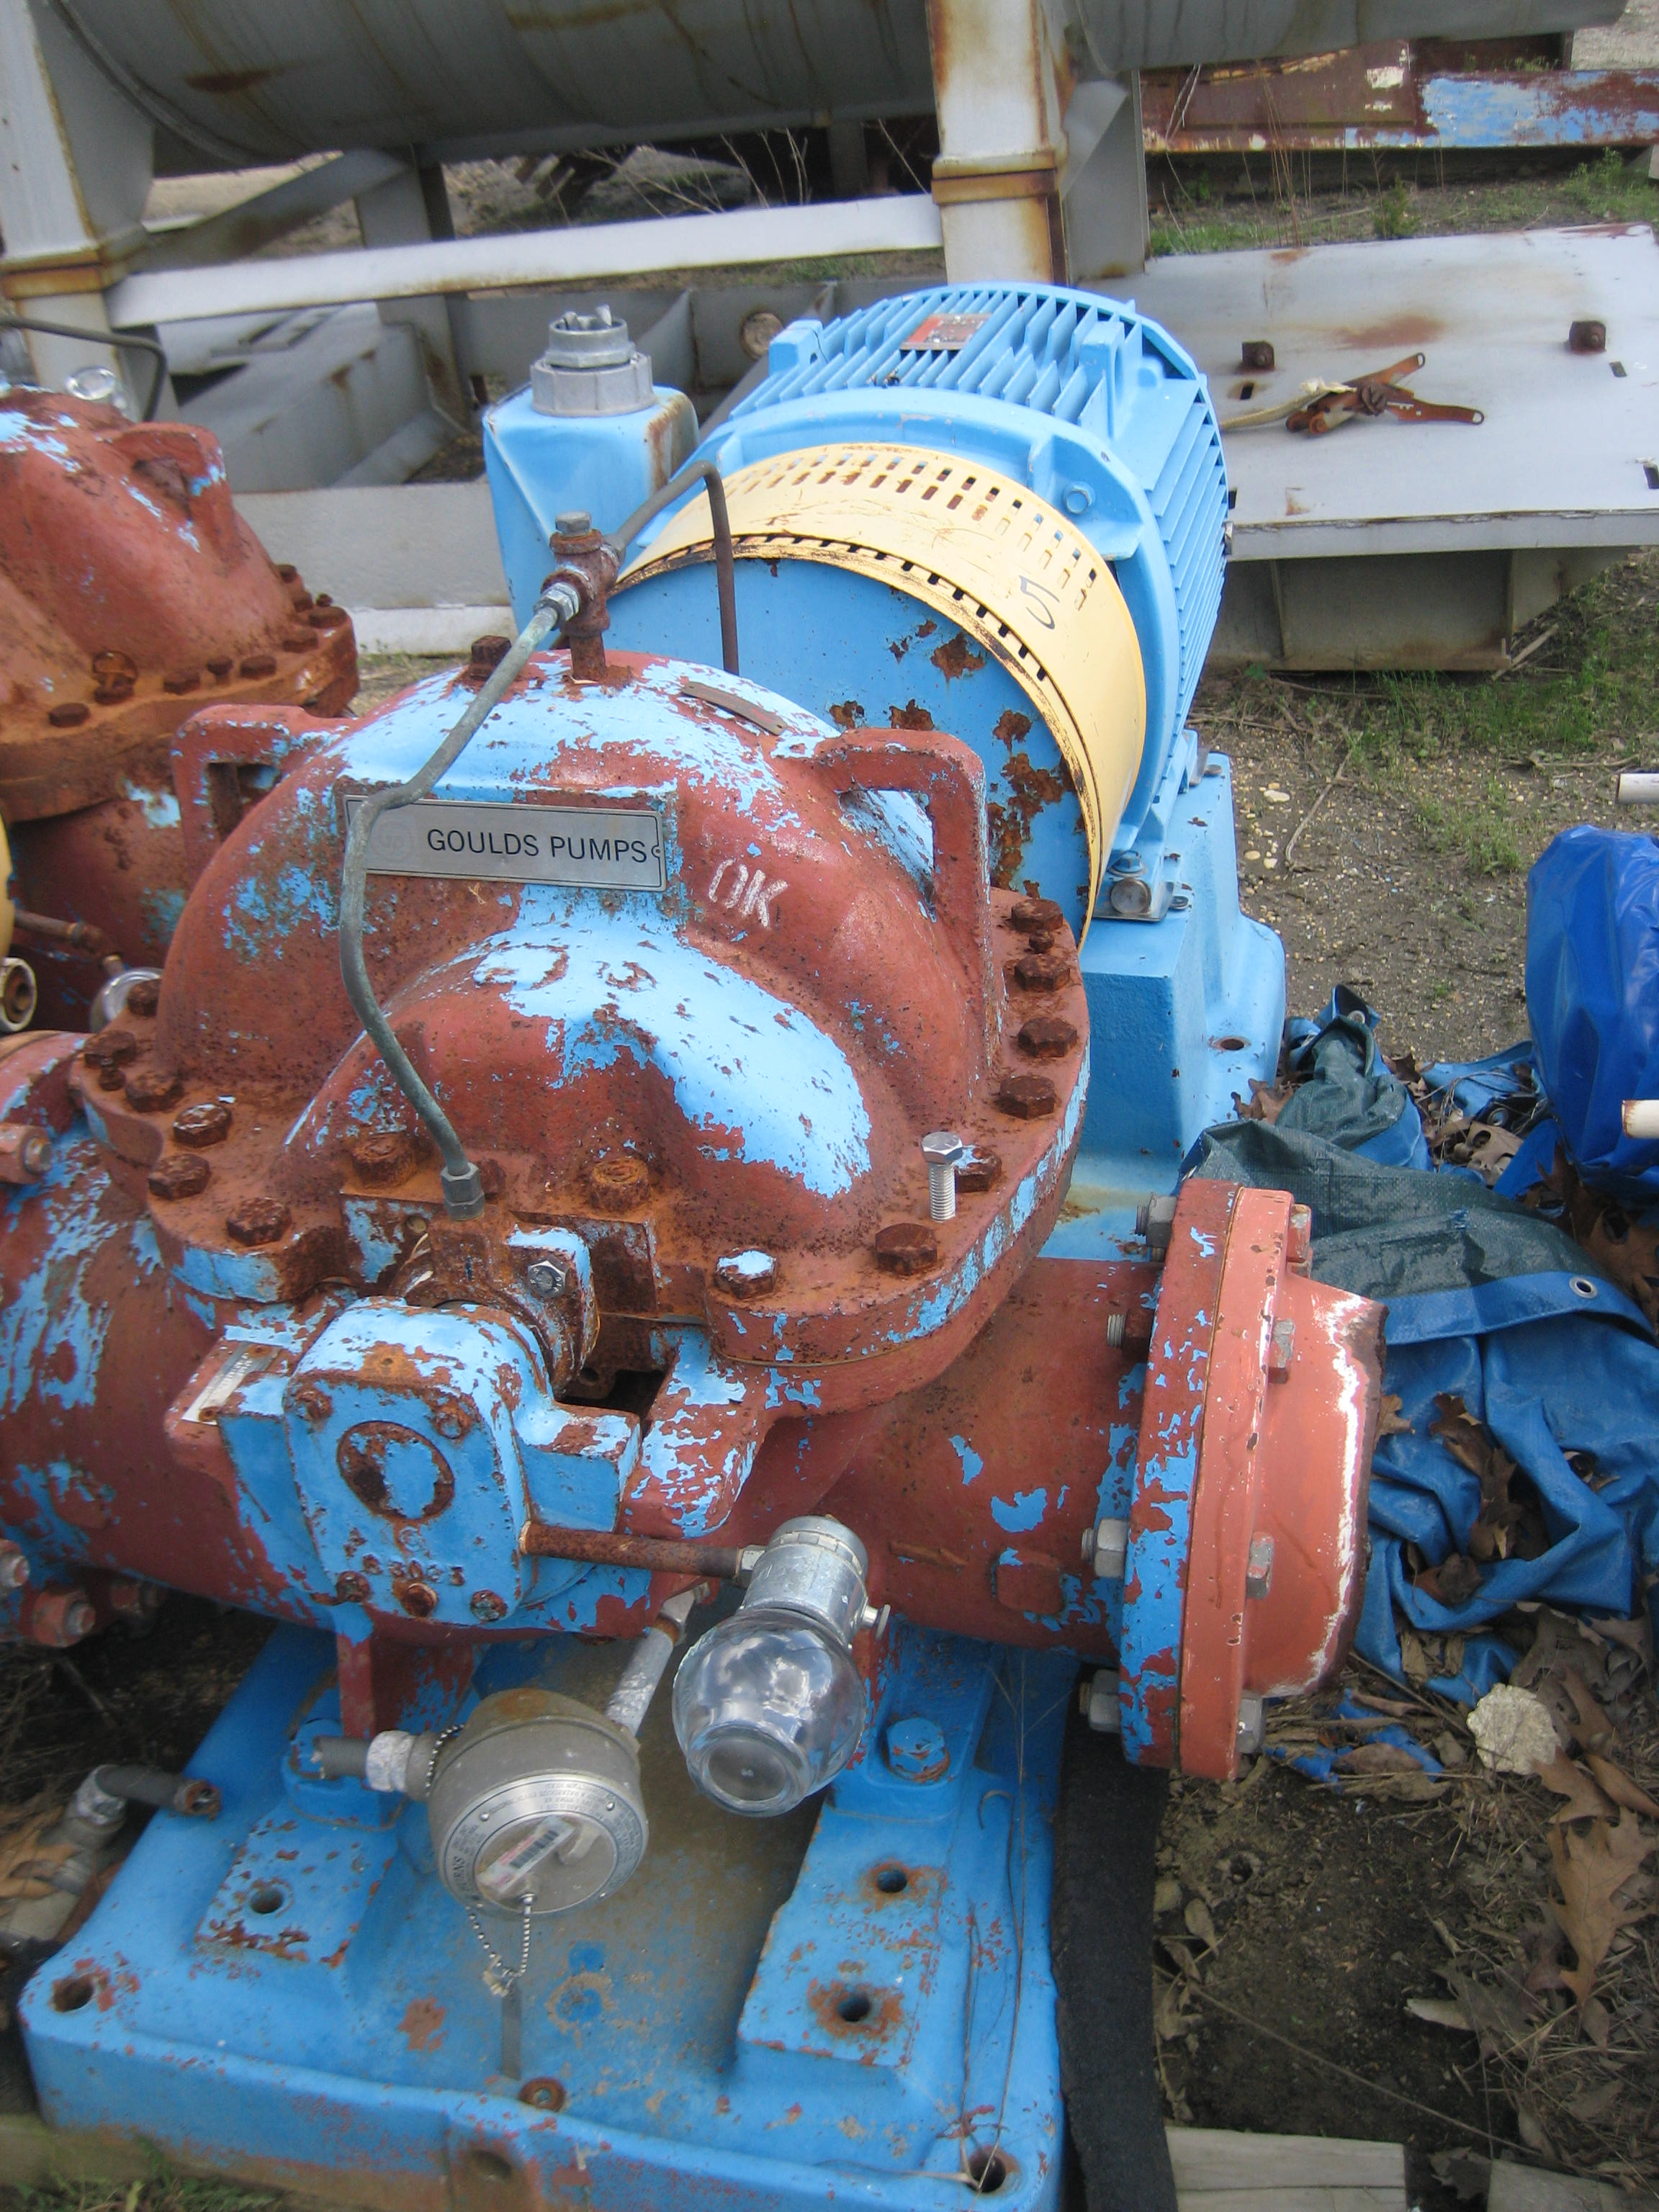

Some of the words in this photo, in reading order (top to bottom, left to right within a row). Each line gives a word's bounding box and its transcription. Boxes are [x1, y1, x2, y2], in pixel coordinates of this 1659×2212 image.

[1018, 575, 1060, 629] 5
[427, 829, 539, 857] GOULDS
[550, 835, 647, 863] PUMPS
[708, 858, 788, 927] OK
